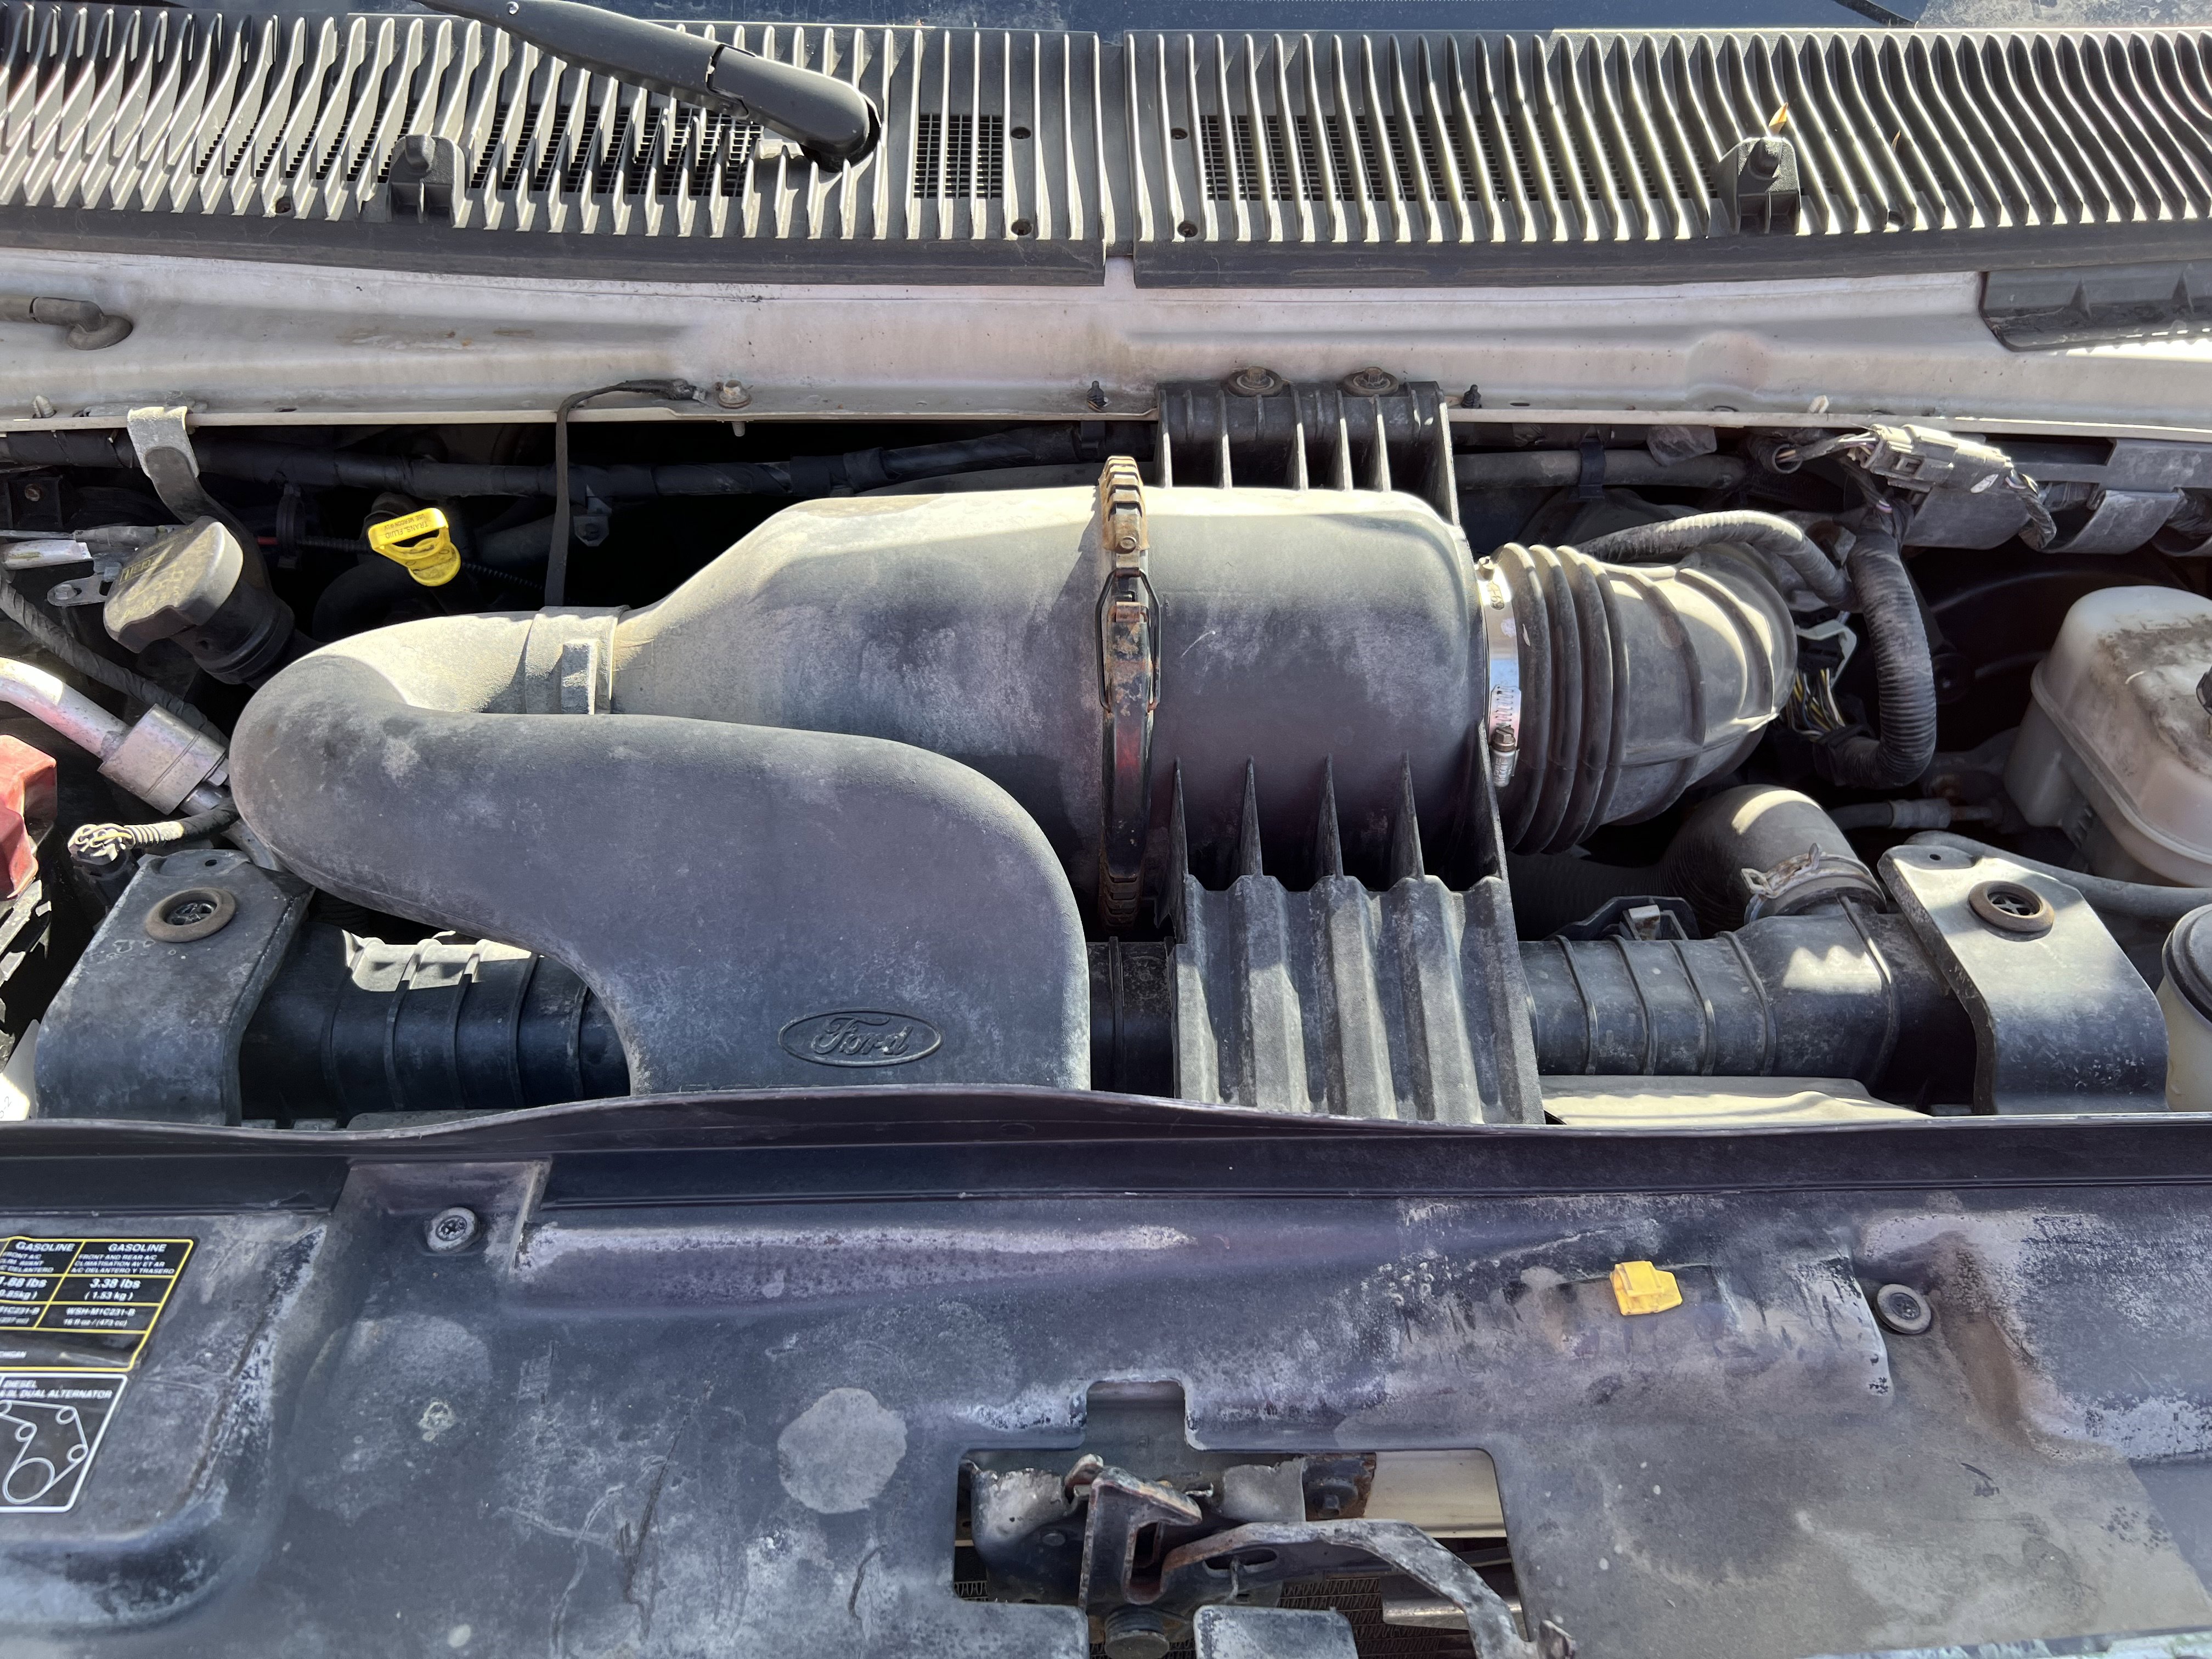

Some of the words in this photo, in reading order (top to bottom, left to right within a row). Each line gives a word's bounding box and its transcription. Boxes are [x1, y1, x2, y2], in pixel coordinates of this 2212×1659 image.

[385, 529, 403, 539] FLUID
[811, 1017, 913, 1055] Ford
[15, 1241, 76, 1252] GASOLINE
[108, 1243, 167, 1252] GASOLINE
[25, 1277, 48, 1288] lbs
[89, 1277, 119, 1289] 3.38
[120, 1278, 142, 1289] lbs
[92, 1291, 113, 1300] 1.53
[114, 1291, 127, 1301] kg
[66, 1307, 136, 1317] WSH-M1C231-B
[3, 1379, 37, 1389] DIESEL
[19, 1389, 46, 1398] DUAL
[47, 1389, 114, 1400] ALTERNATOR
